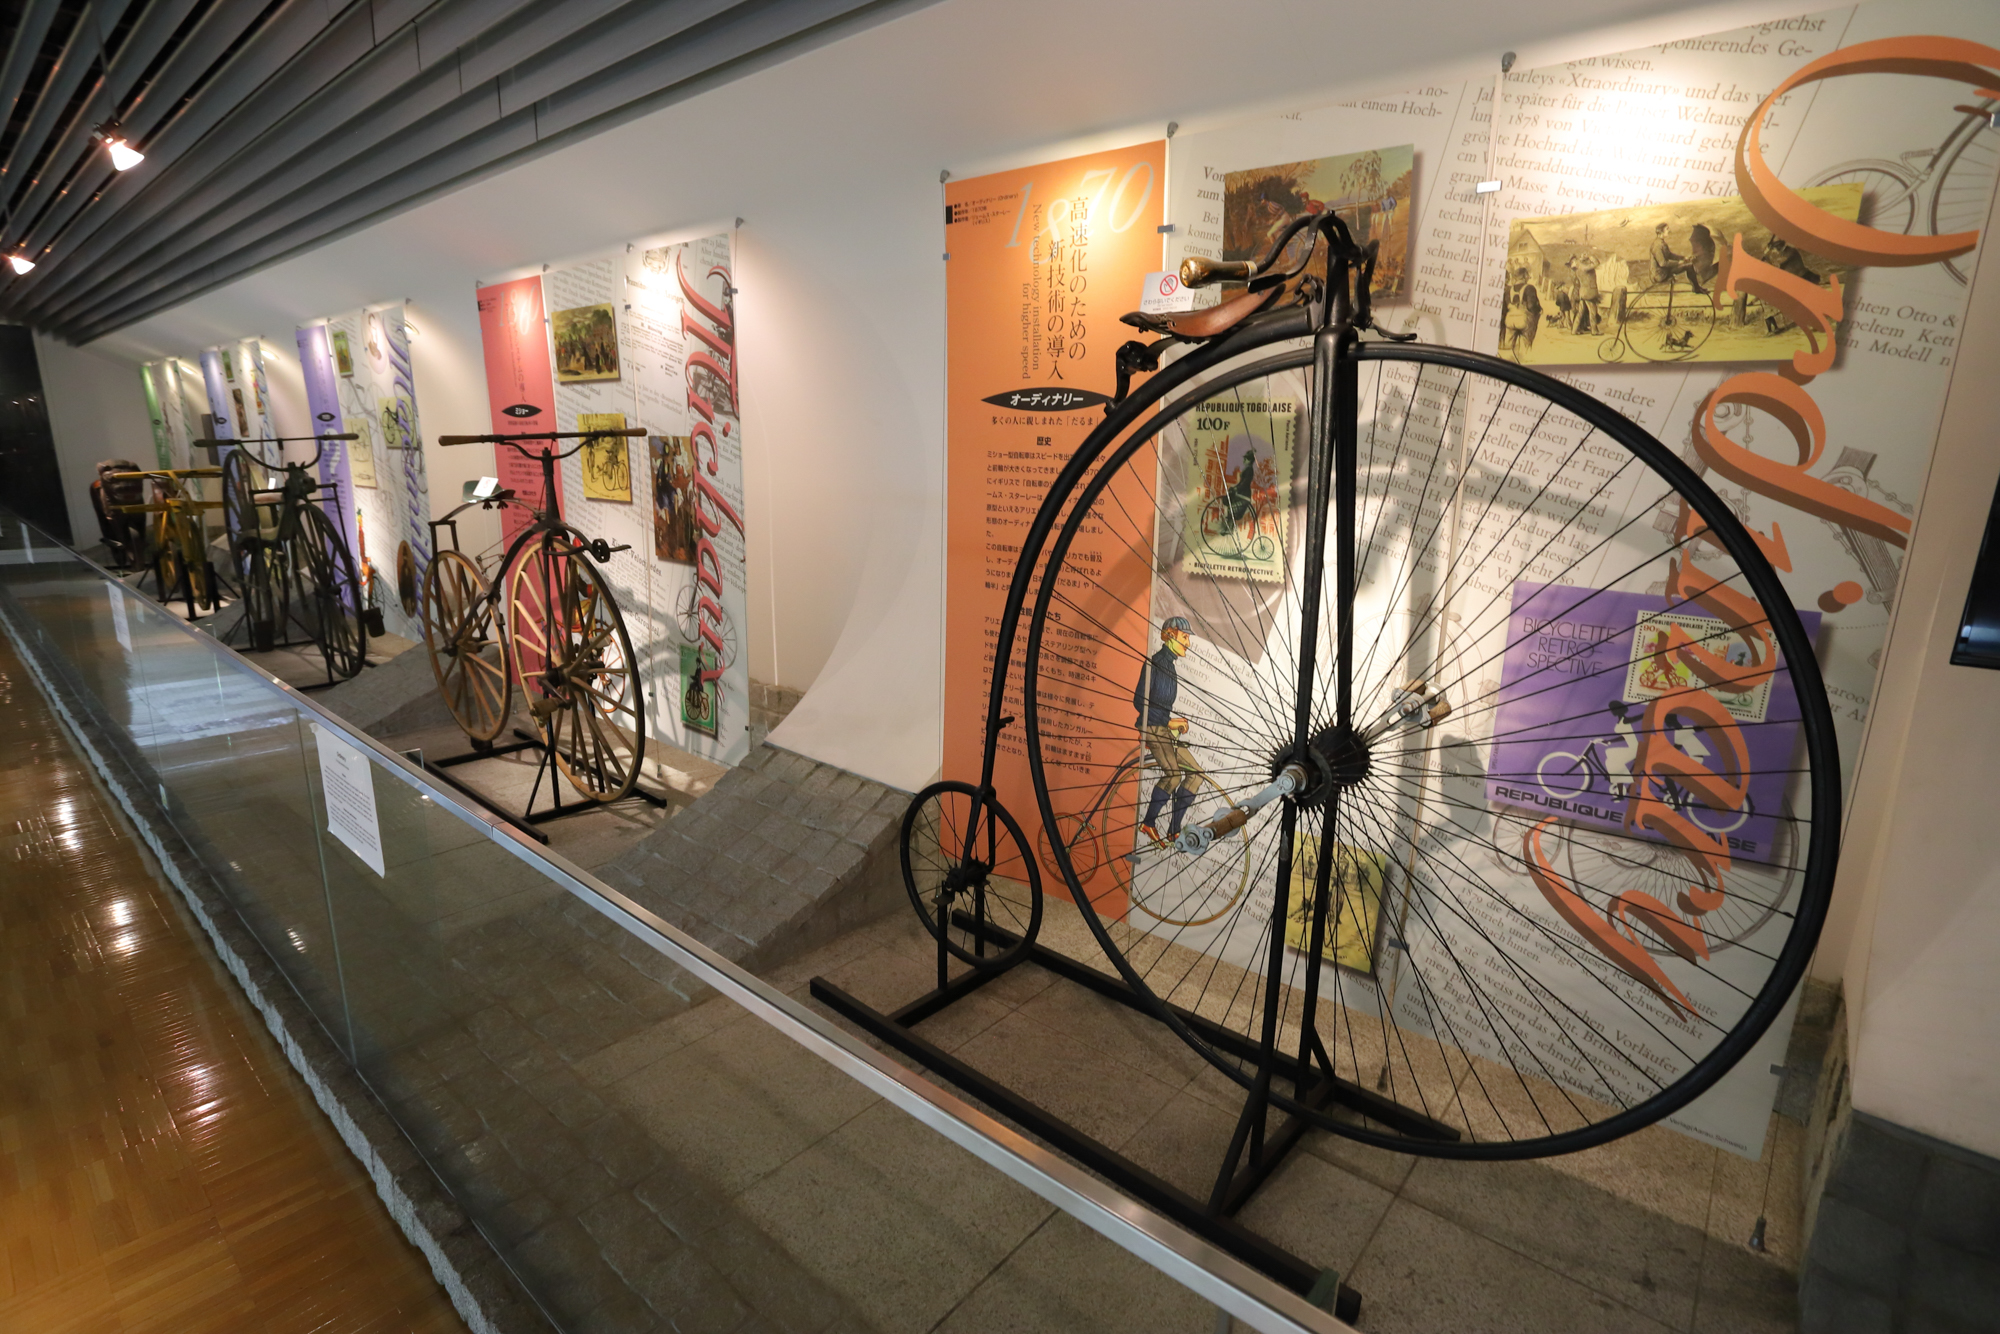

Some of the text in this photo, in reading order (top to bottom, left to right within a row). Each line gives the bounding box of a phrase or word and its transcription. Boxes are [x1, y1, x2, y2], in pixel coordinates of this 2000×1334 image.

[1601, 53, 1654, 71] wissen.
[1514, 92, 1558, 110] später
[1561, 93, 1585, 110] für
[1685, 83, 1720, 101] und
[1722, 84, 1750, 103] das
[1401, 100, 1442, 117] Hoch-
[1508, 112, 1539, 129] 1878
[1514, 133, 1578, 155] Hochrad
[1683, 156, 1726, 174] rund
[1506, 175, 1548, 194] Masse
[1504, 195, 1531, 212] dass
[1202, 211, 1220, 225] Bei
[1187, 224, 1221, 243] konnte
[1432, 227, 1452, 240] ten
[1183, 242, 1213, 257] einem
[1069, 196, 1088, 362] 高速化のための
[1420, 262, 1455, 281] nicht.
[1415, 280, 1471, 303] Hochrad
[1046, 240, 1066, 380] 新技術の導入
[1409, 299, 1442, 316] schen
[1897, 305, 1937, 324] Otto
[1402, 316, 1420, 330] sel.
[1032, 306, 1042, 371] installation
[1869, 339, 1932, 362] Modell
[1010, 393, 1084, 406] オーディナリー
[1604, 386, 1656, 408] andere
[1376, 400, 1397, 416] Die
[1036, 436, 1052, 447] 歴史
[1508, 475, 1533, 495] Das
[1508, 499, 1541, 517] gross
[1576, 517, 1600, 536] bei
[1512, 534, 1531, 552] bei
[1569, 534, 1591, 556] lag
[1559, 576, 1575, 586] so
[1523, 617, 1617, 645] BICYCLETTE
[1526, 652, 1604, 679] SPECTIVE
[1494, 785, 1623, 824] REPUBLIQUE
[1483, 924, 1541, 964] nach hinten.
[1486, 900, 1502, 913] die
[1612, 968, 1636, 987] Rad
[1509, 926, 1531, 943] und
[1535, 940, 1577, 969] verlegte
[1623, 989, 1704, 1040] Schwerpunkt
[1425, 957, 1449, 976] men
[1528, 1015, 1549, 1035] das
[1484, 974, 1514, 997] weiss
[1516, 993, 1542, 1014] man
[1463, 944, 1479, 959] sie
[1484, 955, 1516, 981] ihren
[1616, 1029, 1680, 1076] Vorläufer
[1464, 1010, 1490, 1033] bald
[1478, 1038, 1491, 1050] so
[1536, 1039, 1587, 1075] schnelle
